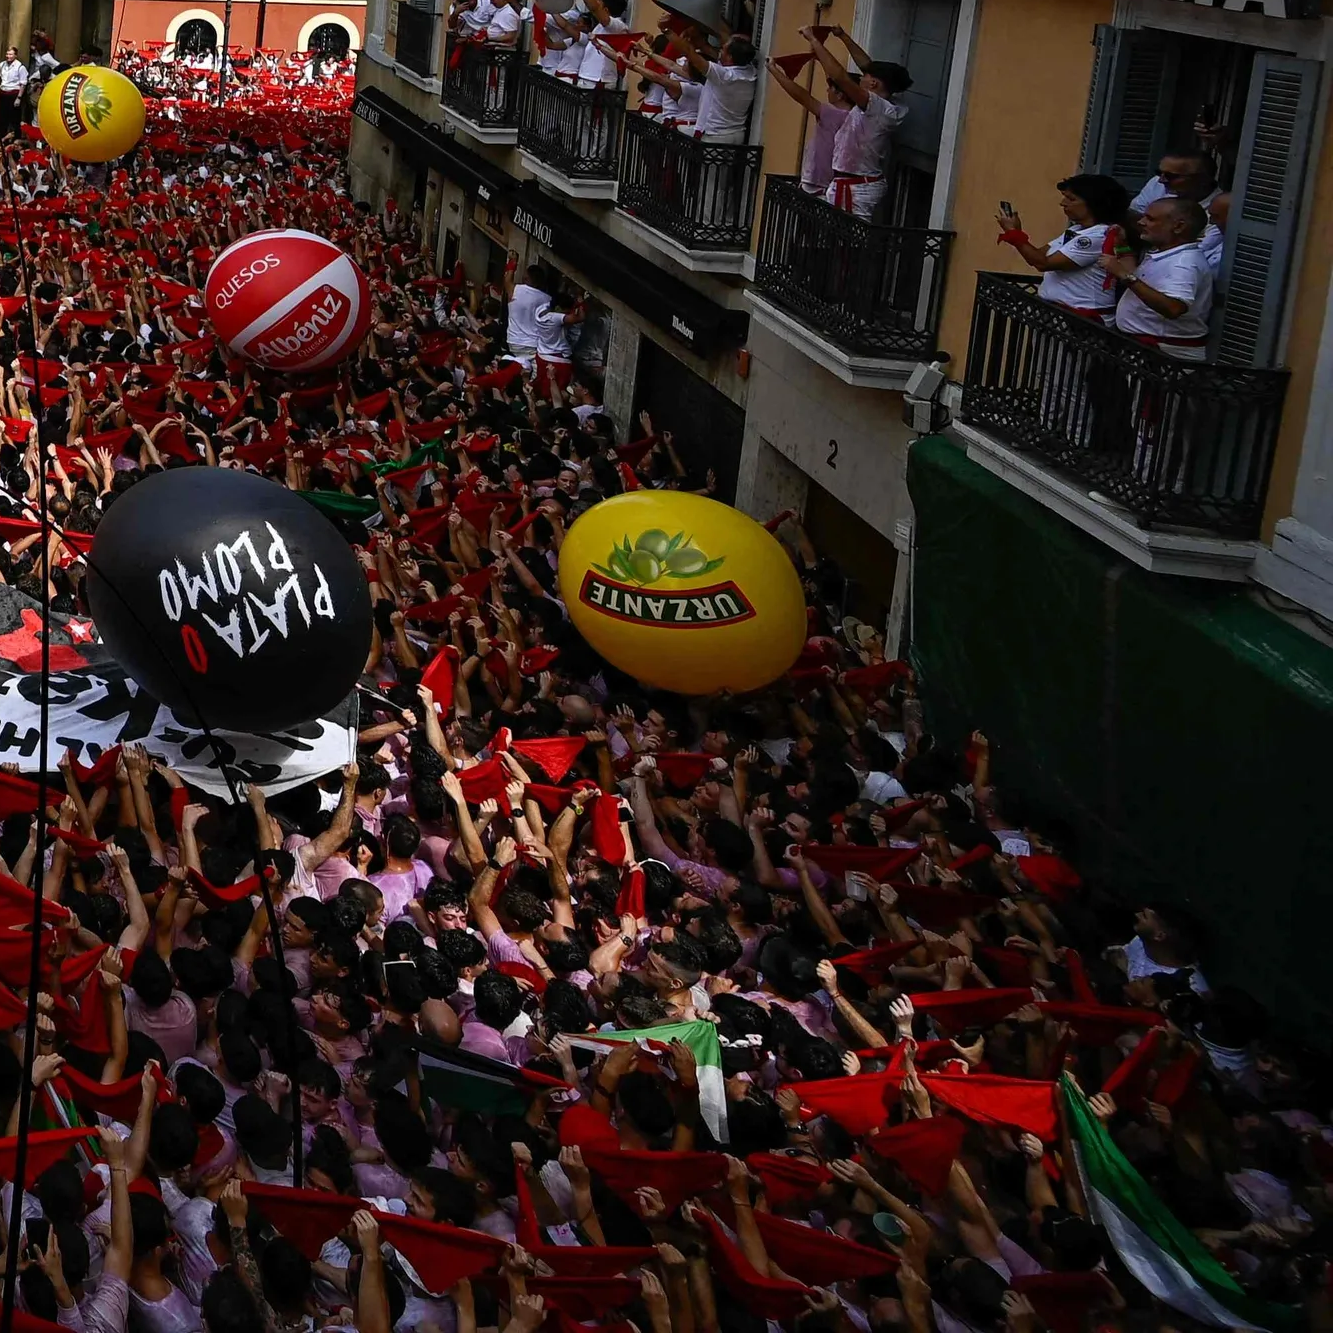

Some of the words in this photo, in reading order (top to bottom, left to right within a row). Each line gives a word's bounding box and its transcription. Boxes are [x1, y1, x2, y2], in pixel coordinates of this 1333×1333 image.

[64, 75, 83, 134] URZANTE
[514, 206, 533, 234] BAR
[533, 218, 553, 248] MOL
[215, 253, 281, 309] QUESOS
[257, 293, 343, 363] Albéniz
[298, 335, 329, 357] Quesos
[826, 439, 838, 470] 2
[158, 520, 295, 622] PLOMO
[201, 561, 336, 659] PLATA
[589, 581, 740, 622] URZANTE
[180, 623, 209, 676] O
